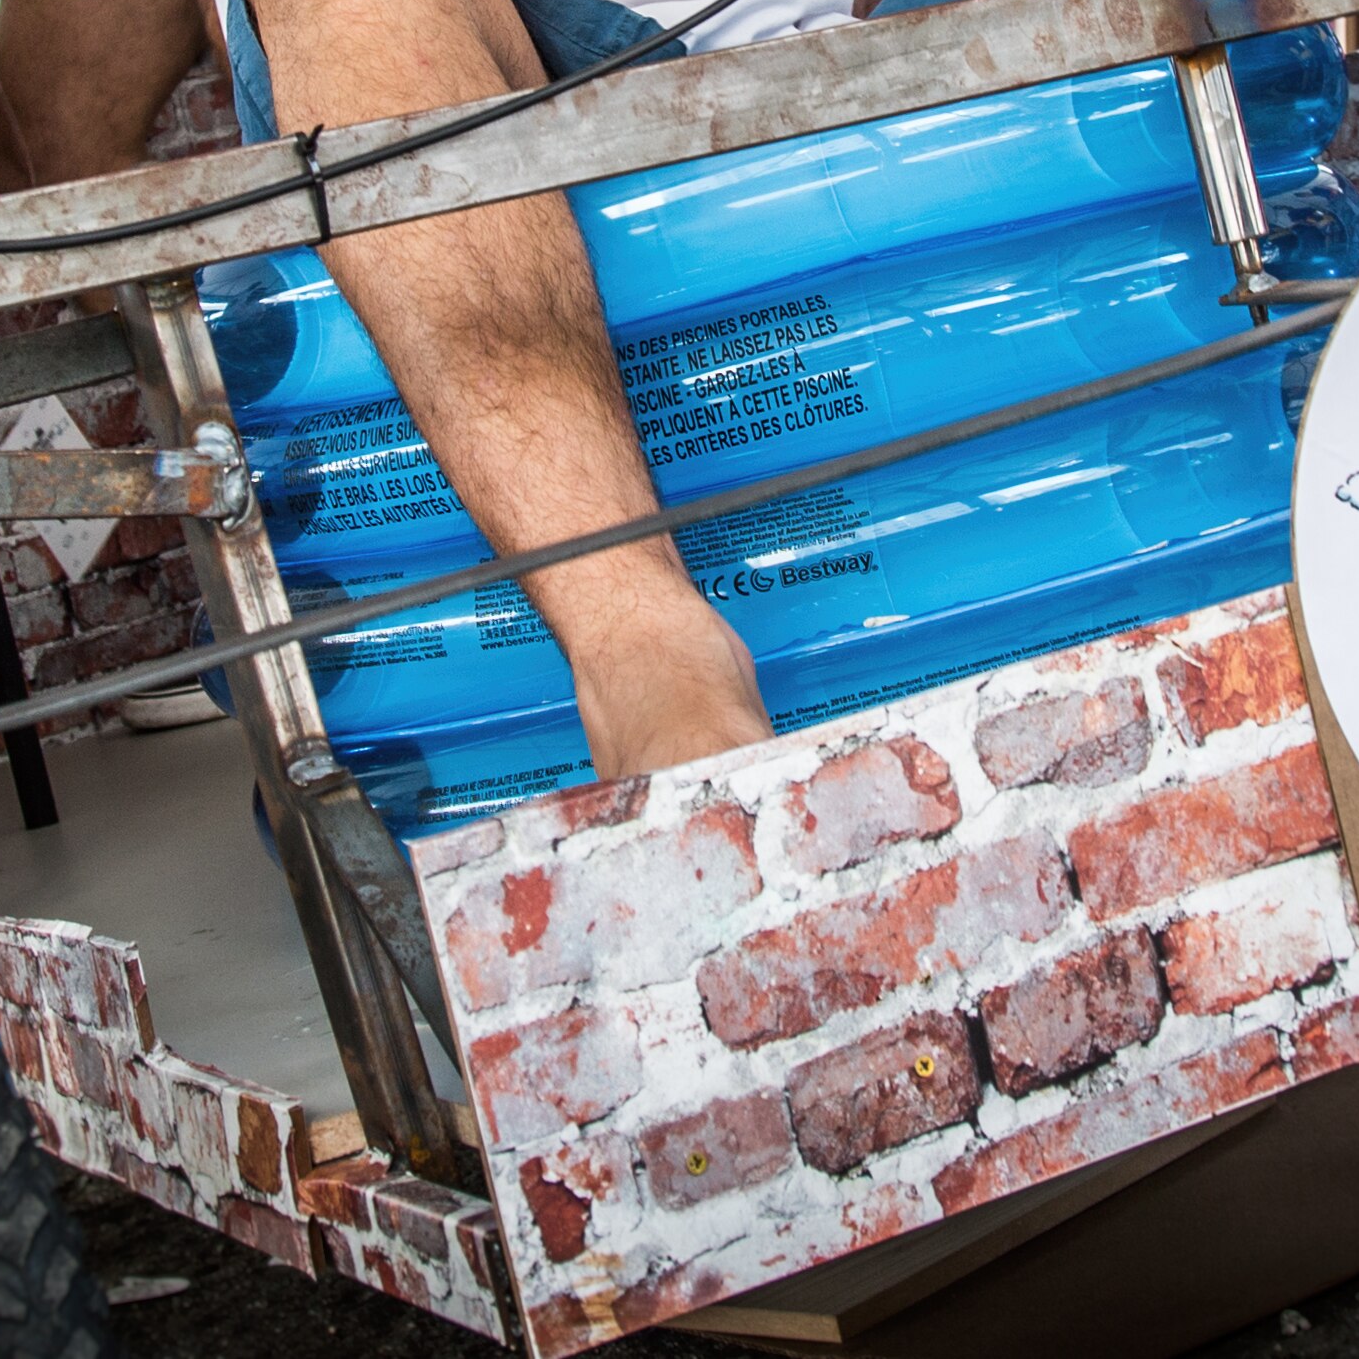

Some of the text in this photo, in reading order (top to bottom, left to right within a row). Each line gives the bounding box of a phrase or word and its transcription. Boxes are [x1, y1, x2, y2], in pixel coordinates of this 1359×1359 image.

[641, 337, 668, 358] DES
[671, 317, 737, 349] PISCINES
[742, 294, 832, 330] PORTABLES.
[688, 348, 708, 371] NE
[711, 331, 774, 366] LAISSEZ
[776, 325, 806, 348] PAS
[809, 314, 838, 338] LES
[693, 356, 790, 399] GARDEZ-LES
[792, 346, 806, 373] À
[641, 367, 859, 442] PPLIQUENT À CETTE PISCINE.
[284, 432, 357, 461] ASSUREZ-VOUS
[359, 426, 393, 449] D'UNE
[675, 425, 749, 462] CRITÈRES
[753, 417, 783, 440] DES
[785, 393, 869, 432] CLÔTURES.
[328, 462, 357, 482] SANS
[289, 491, 329, 516] PORTER
[332, 489, 345, 508] DE
[346, 483, 382, 505] BRAS.
[381, 479, 407, 500] LES
[409, 473, 437, 496] LOIS
[298, 511, 362, 536] CONSULTEZ
[359, 508, 384, 528] LES
[385, 496, 452, 525] AUTORITÉS
[754, 531, 776, 542] States
[785, 523, 814, 535] America
[827, 530, 856, 543] Bestway
[779, 551, 874, 589] Bestway
[796, 702, 829, 716] Shanghai,
